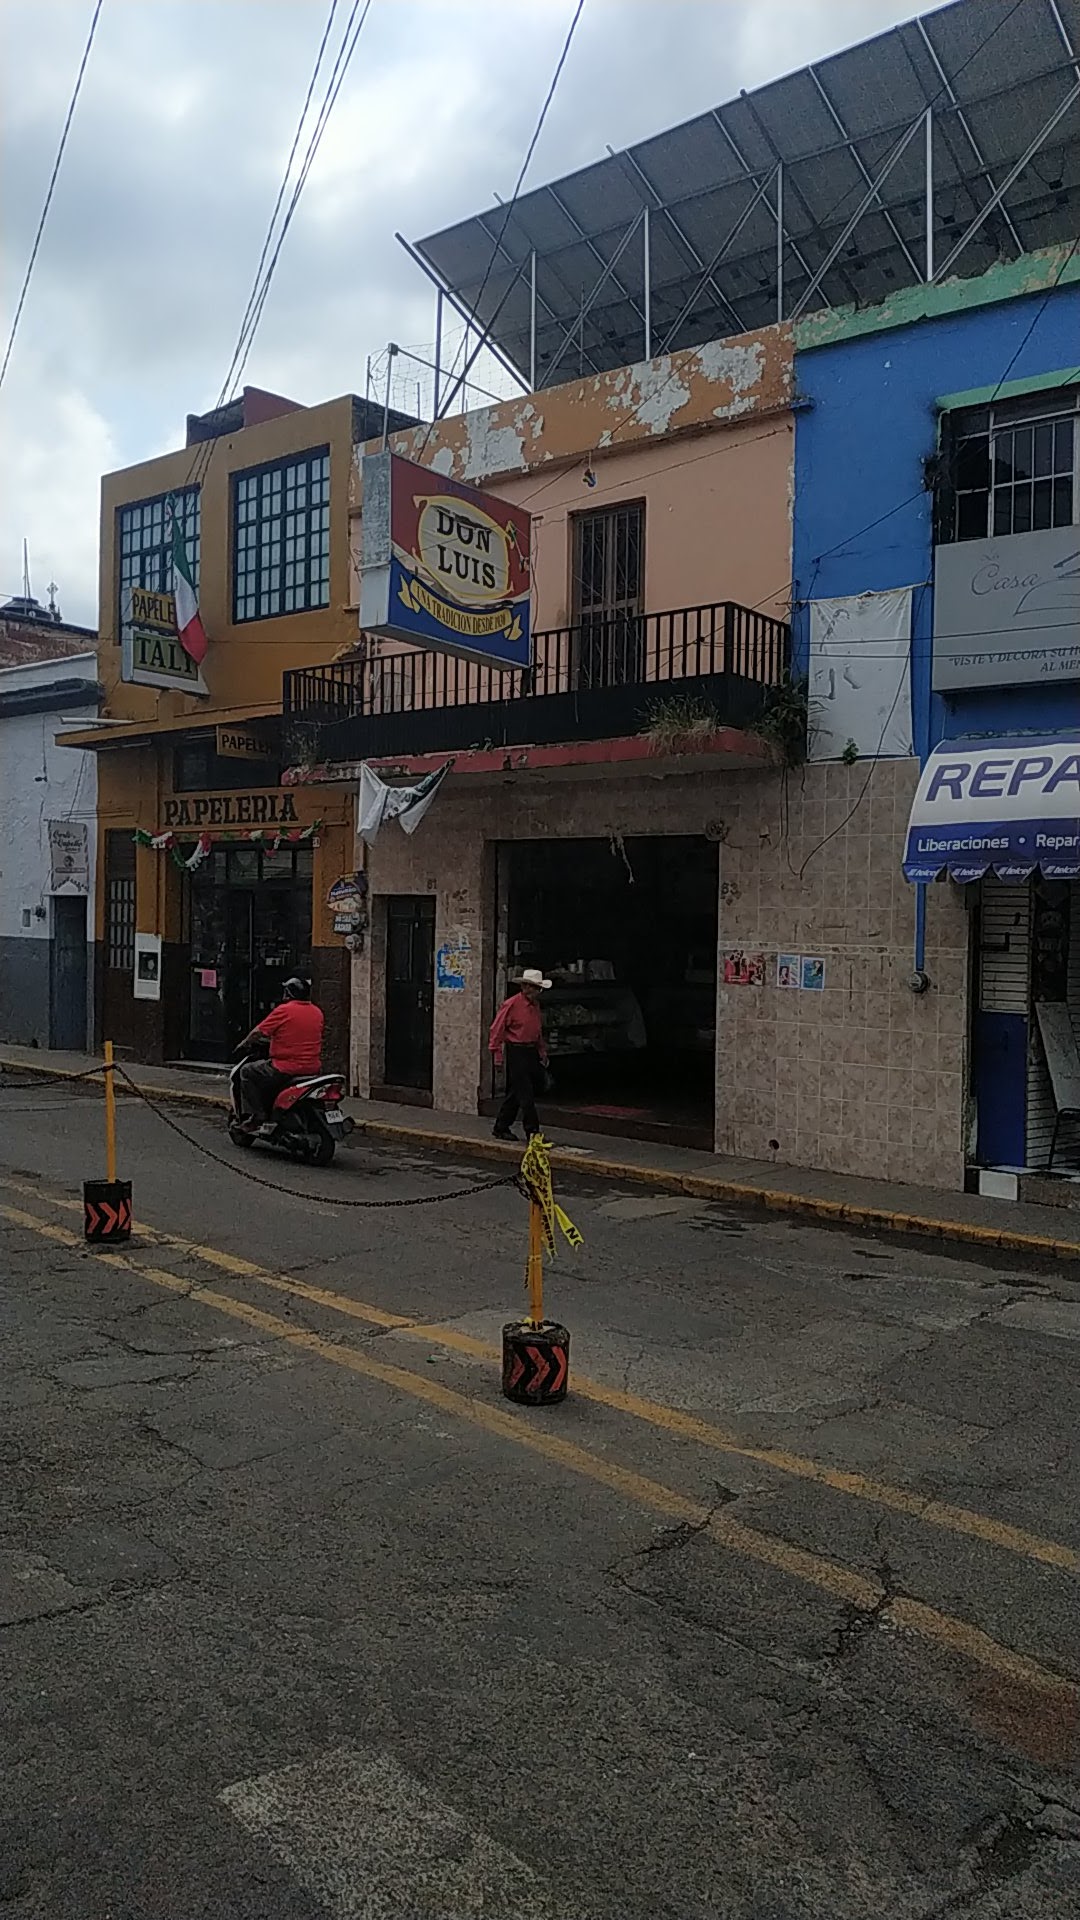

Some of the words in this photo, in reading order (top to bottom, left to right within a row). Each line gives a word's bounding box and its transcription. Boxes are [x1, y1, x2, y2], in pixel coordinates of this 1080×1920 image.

[437, 509, 492, 553] DON
[437, 544, 496, 589] LUIS
[971, 563, 1039, 596] Casa
[432, 600, 471, 632] TRADICION
[472, 614, 494, 634] DESDE
[996, 650, 1046, 662] DECORA
[1040, 661, 1057, 672] AL
[925, 754, 1080, 801] REPA
[164, 793, 299, 826] PAPELERIA
[917, 836, 1010, 852] Liberaciones
